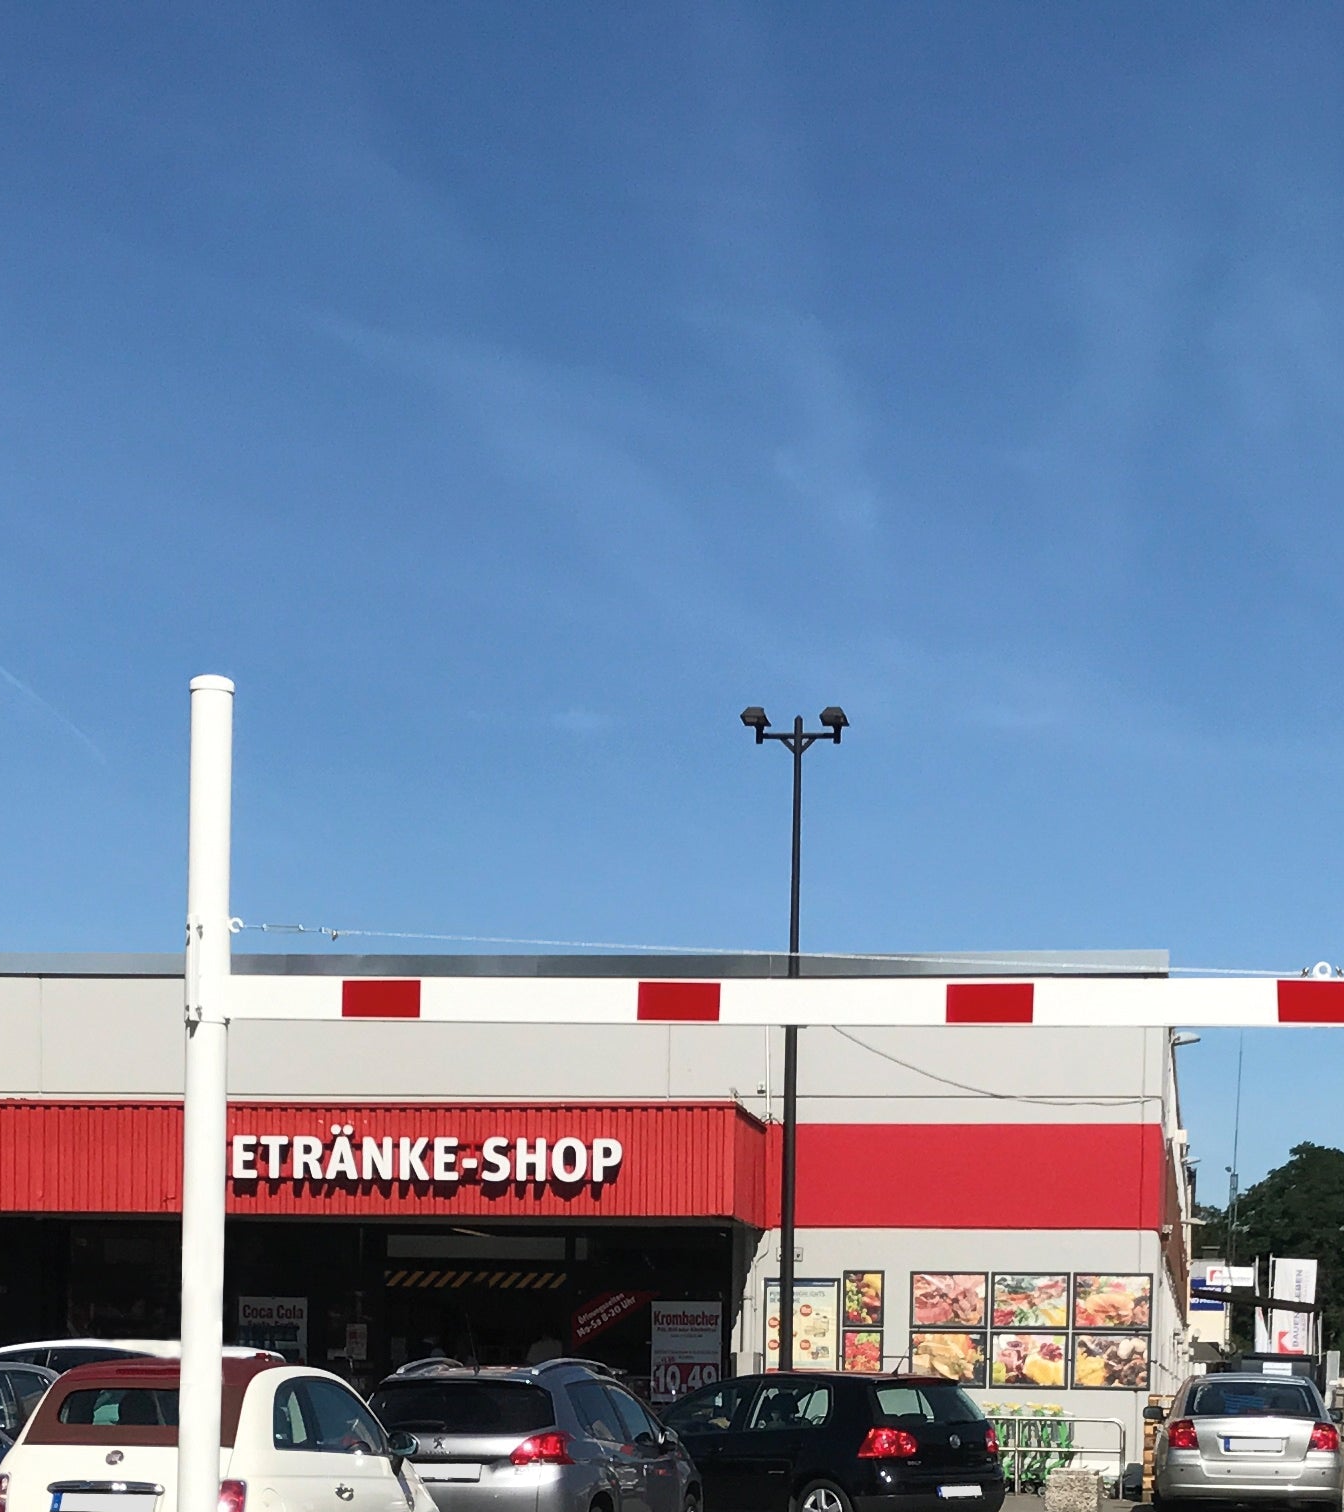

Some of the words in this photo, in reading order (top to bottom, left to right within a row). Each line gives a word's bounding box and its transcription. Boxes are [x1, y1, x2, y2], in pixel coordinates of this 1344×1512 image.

[232, 1124, 623, 1183] ETRÄNKE-SHOP
[242, 1304, 274, 1320] Coca
[276, 1304, 304, 1320] Cola
[653, 1310, 720, 1326] Krombacher
[654, 1364, 717, 1396] 10.49
